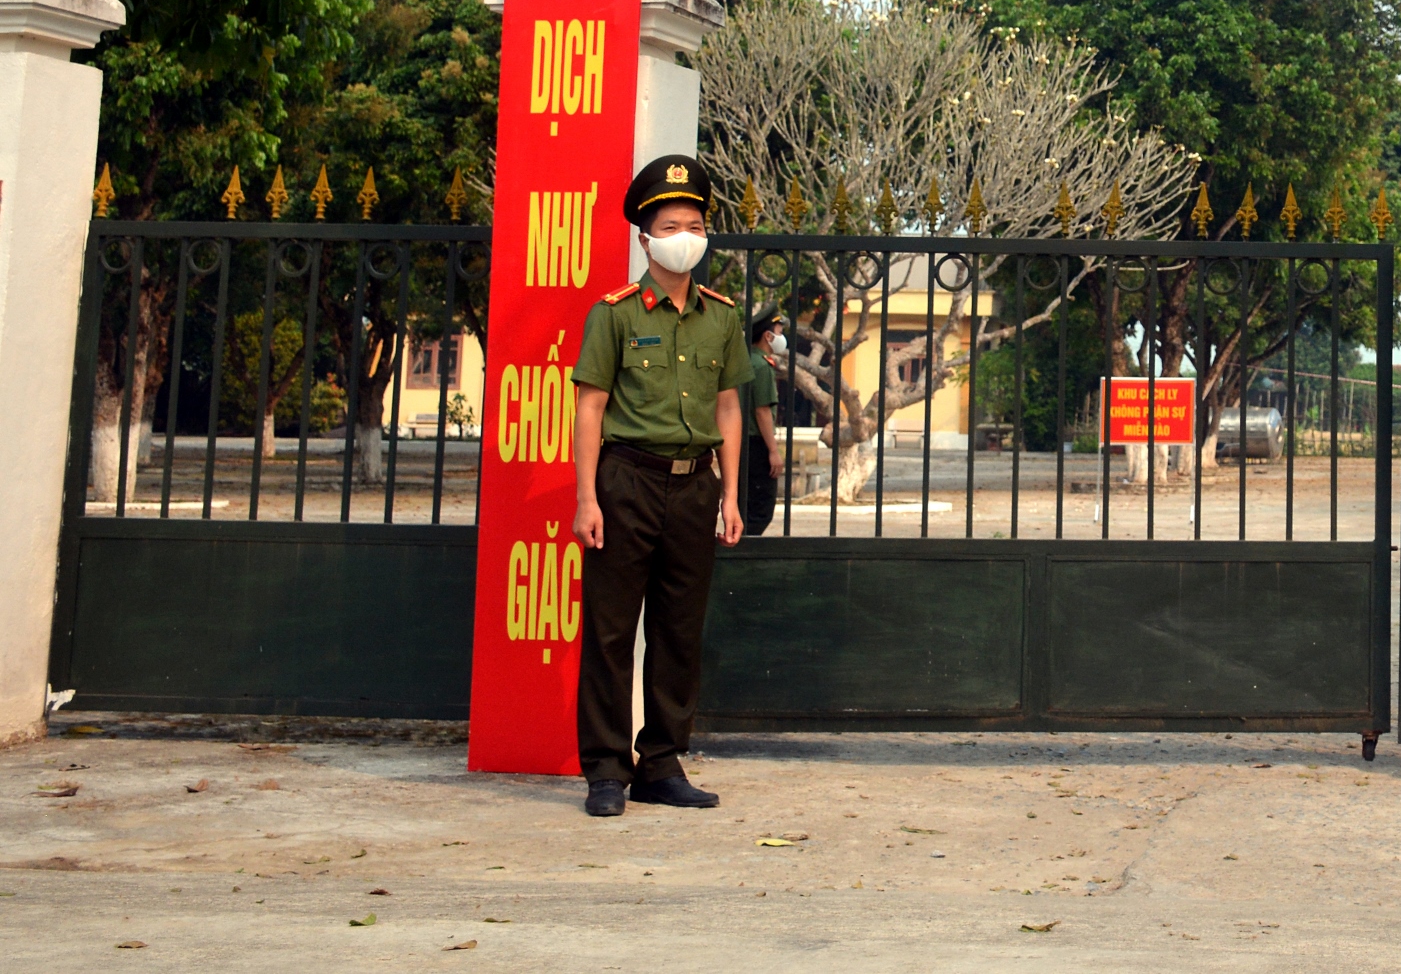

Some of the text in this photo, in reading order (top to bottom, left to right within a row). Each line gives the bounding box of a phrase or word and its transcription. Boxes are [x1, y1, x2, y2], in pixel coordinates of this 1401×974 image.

[530, 19, 606, 137] DỊCH
[526, 181, 598, 289] NHƯ
[497, 329, 579, 465] CHỐN
[1117, 388, 1137, 400] KHU
[1168, 388, 1178, 400] LY
[1143, 404, 1169, 420] PẬN
[507, 521, 582, 664] GIẶC
